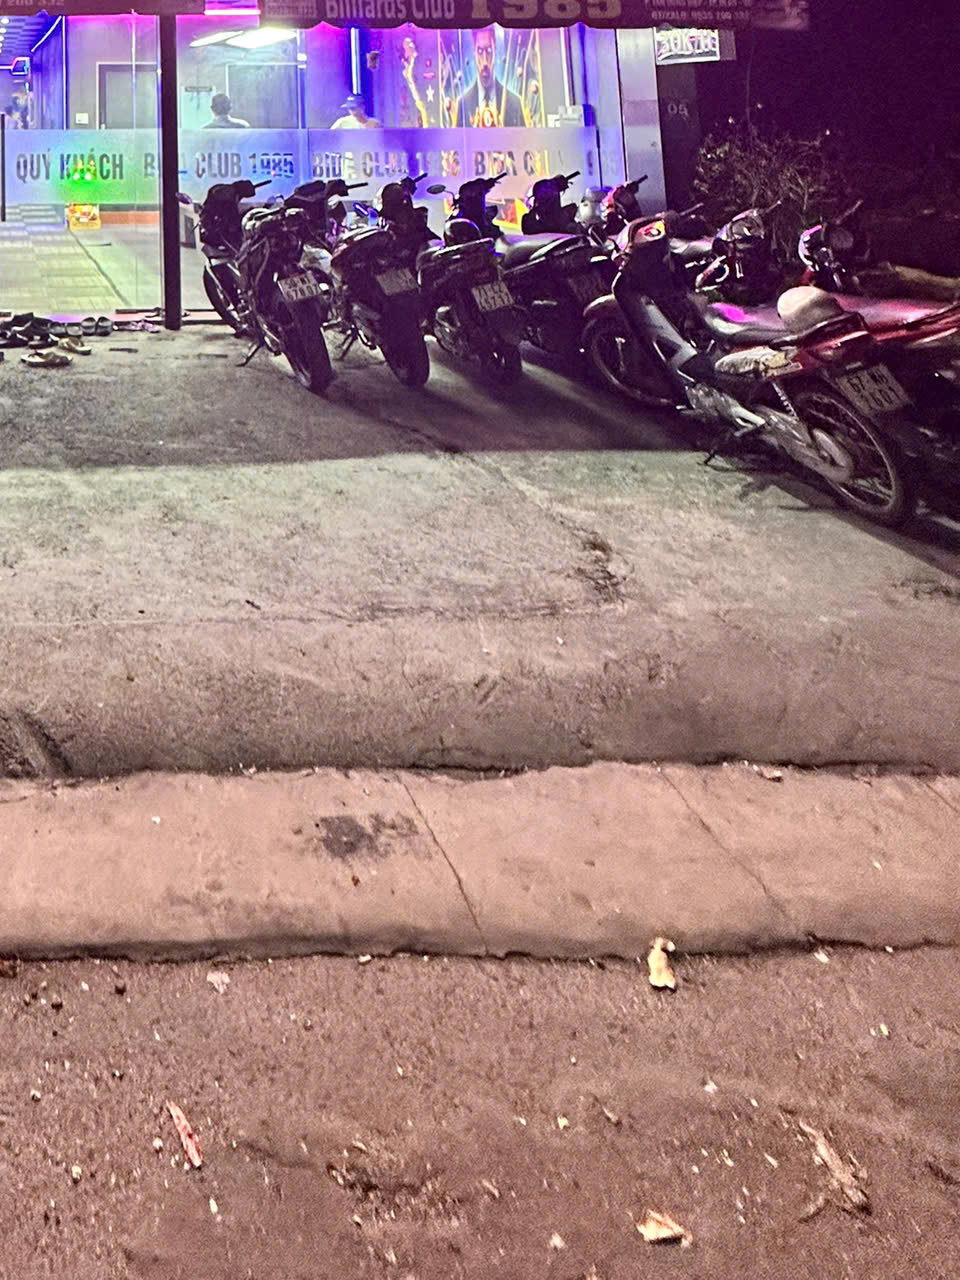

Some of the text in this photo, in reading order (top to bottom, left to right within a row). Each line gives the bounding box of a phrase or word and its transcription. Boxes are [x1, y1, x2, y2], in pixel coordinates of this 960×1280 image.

[16, 147, 52, 184] QUÝ
[59, 147, 124, 181] KHÁCH
[194, 152, 242, 179] CLUB
